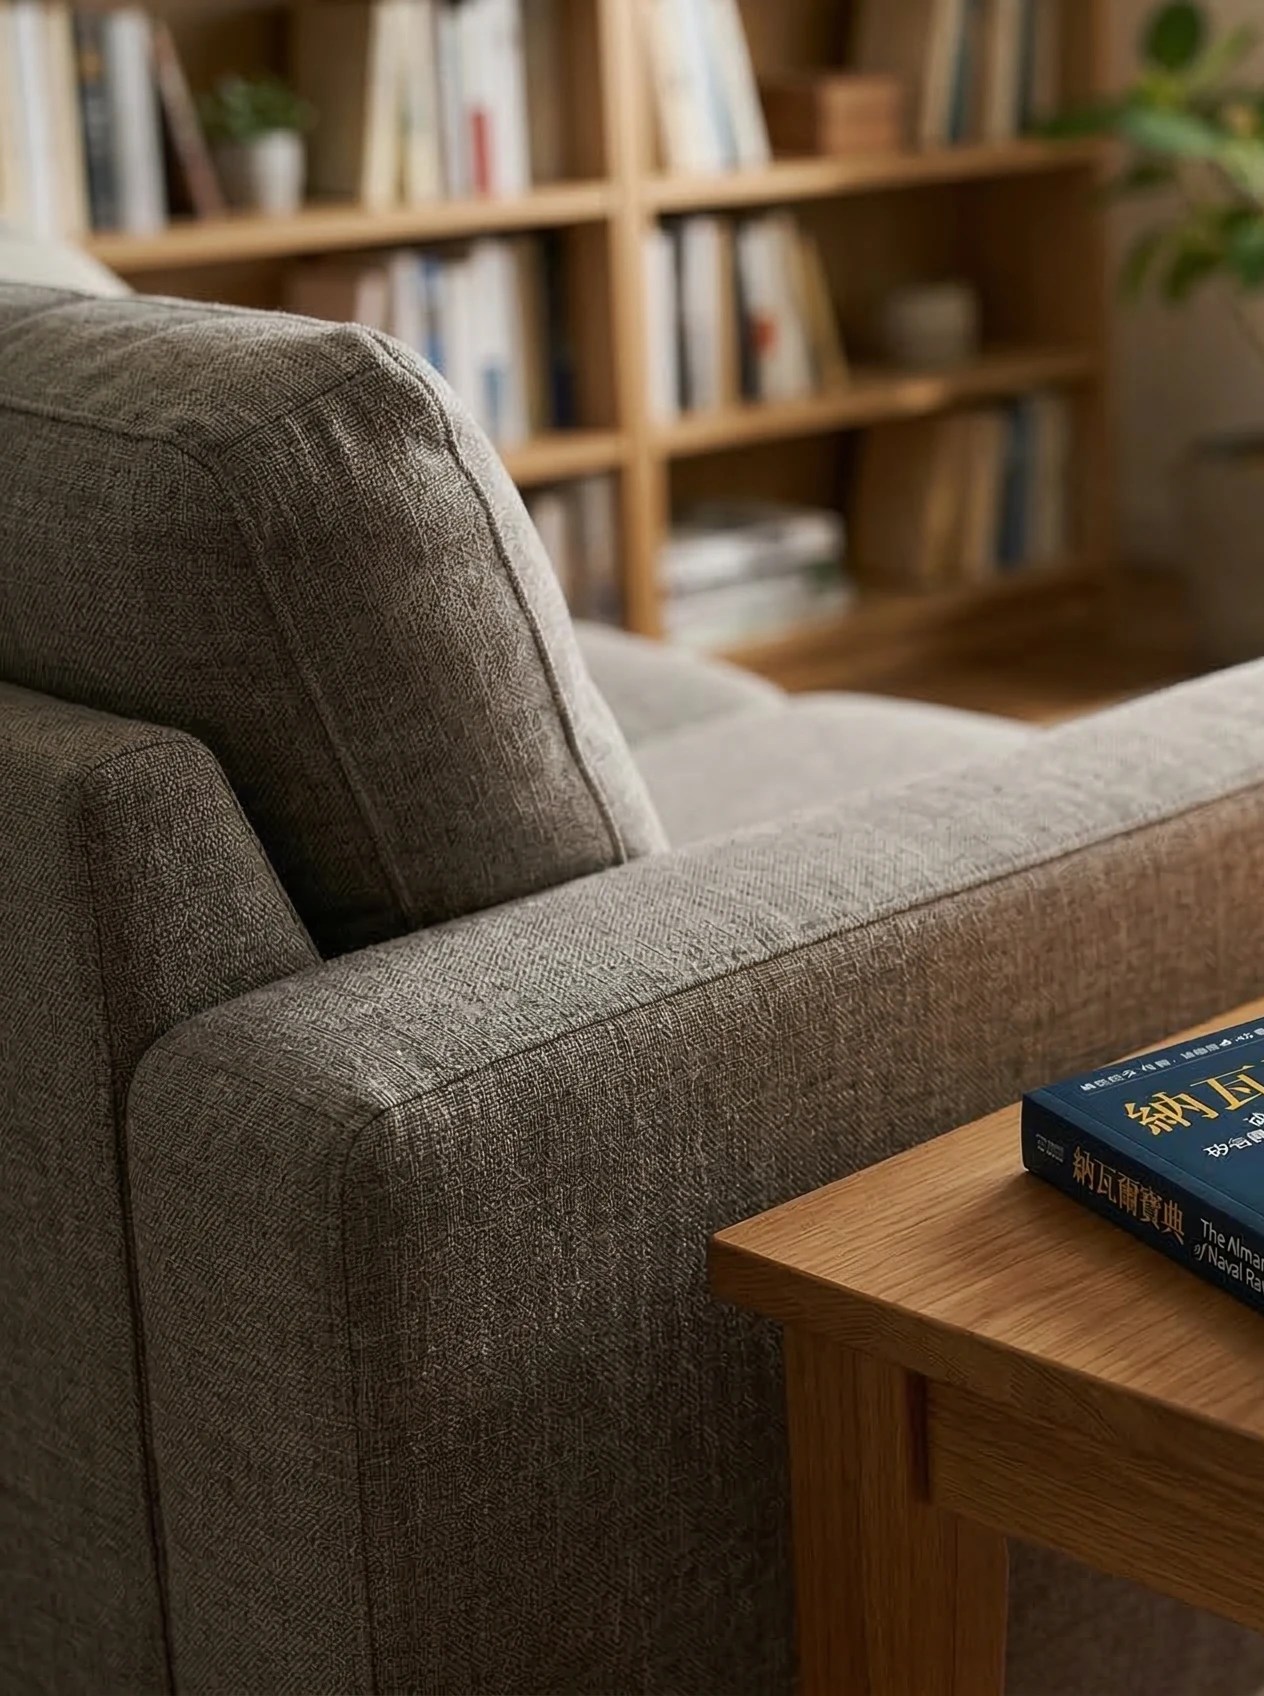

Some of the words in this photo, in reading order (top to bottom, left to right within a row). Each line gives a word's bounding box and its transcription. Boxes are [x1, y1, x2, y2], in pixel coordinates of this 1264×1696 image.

[1072, 1146, 1185, 1246] 納瓦爾寶典
[1200, 1218, 1226, 1250] The
[1208, 1248, 1243, 1280] Naval
